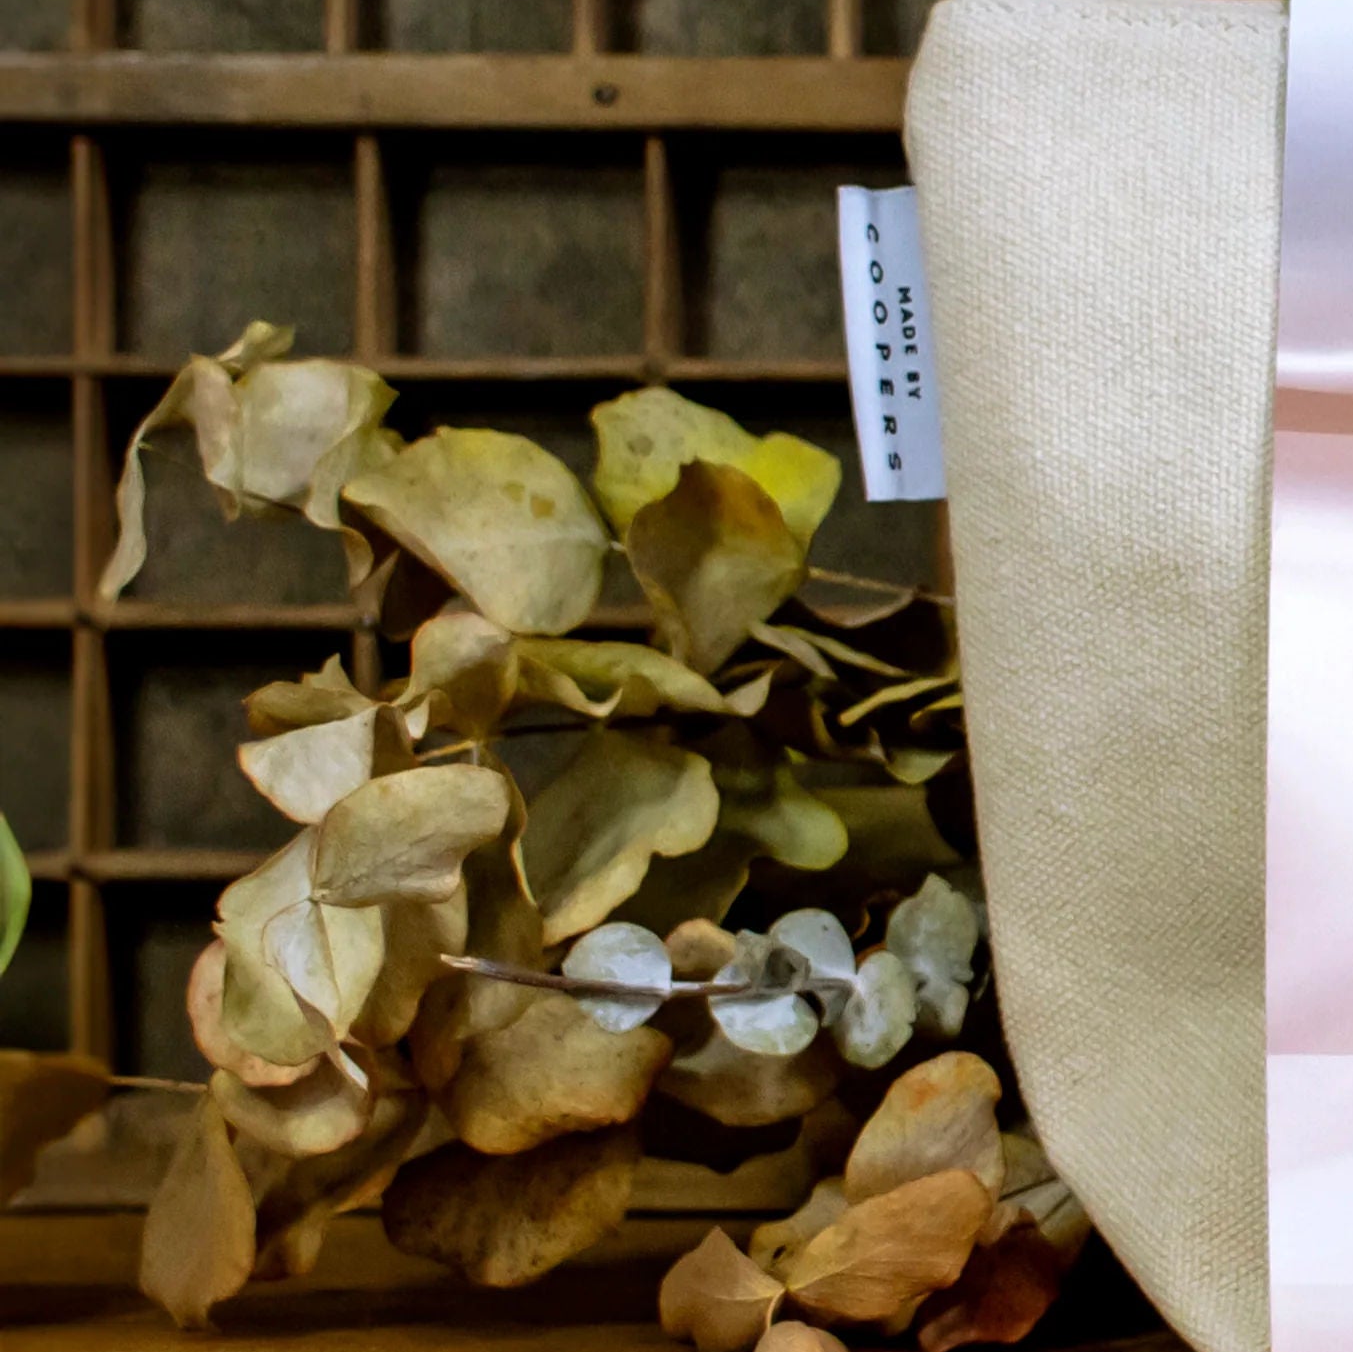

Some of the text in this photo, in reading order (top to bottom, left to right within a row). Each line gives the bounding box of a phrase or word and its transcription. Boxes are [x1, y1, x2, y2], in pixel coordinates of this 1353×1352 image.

[866, 222, 903, 471] COOPERS
[897, 286, 922, 400] MADE BY
